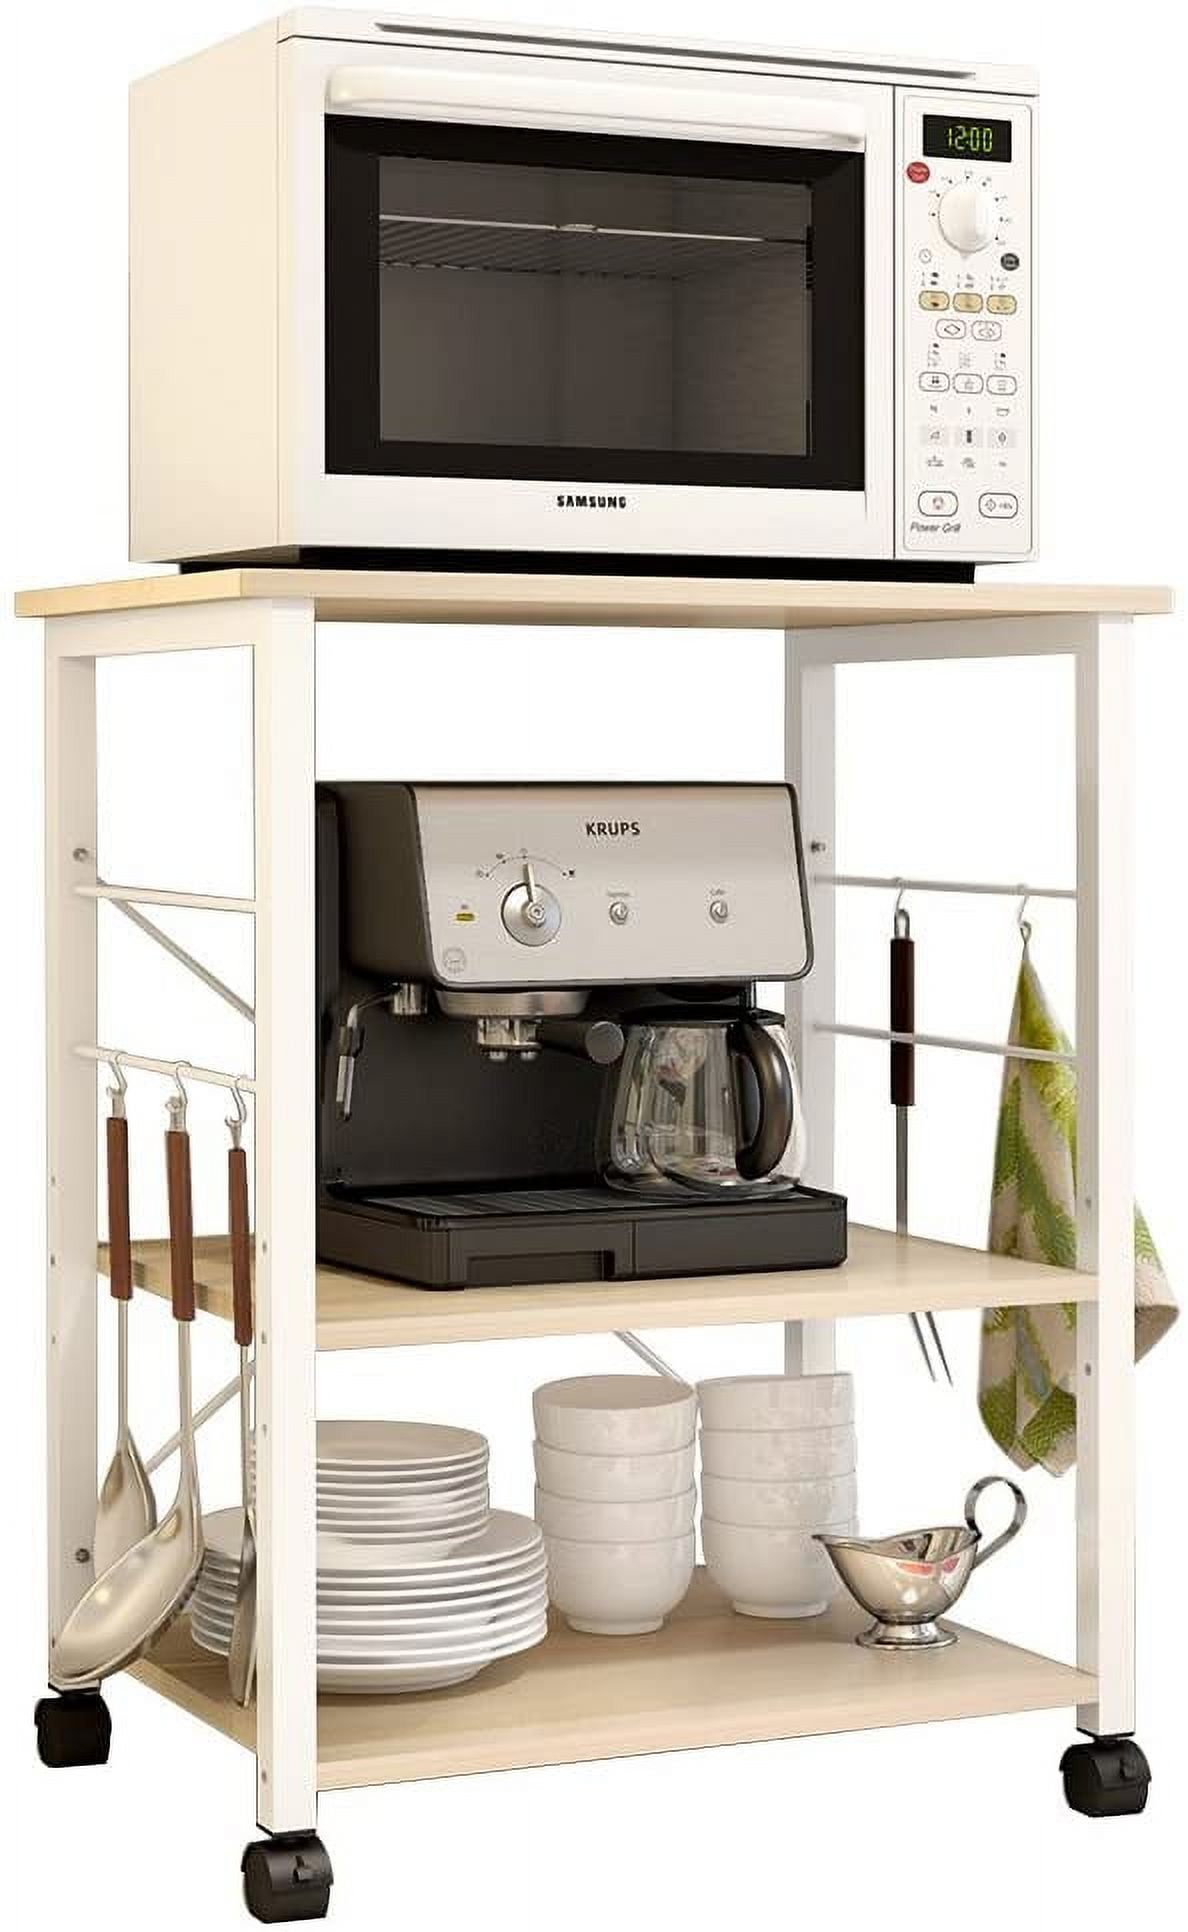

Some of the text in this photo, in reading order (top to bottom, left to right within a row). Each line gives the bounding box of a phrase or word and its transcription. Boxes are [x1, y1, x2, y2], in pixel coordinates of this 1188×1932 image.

[556, 494, 627, 509] SAMSUNG
[910, 521, 940, 533] Power
[585, 821, 641, 837] KRUPS
